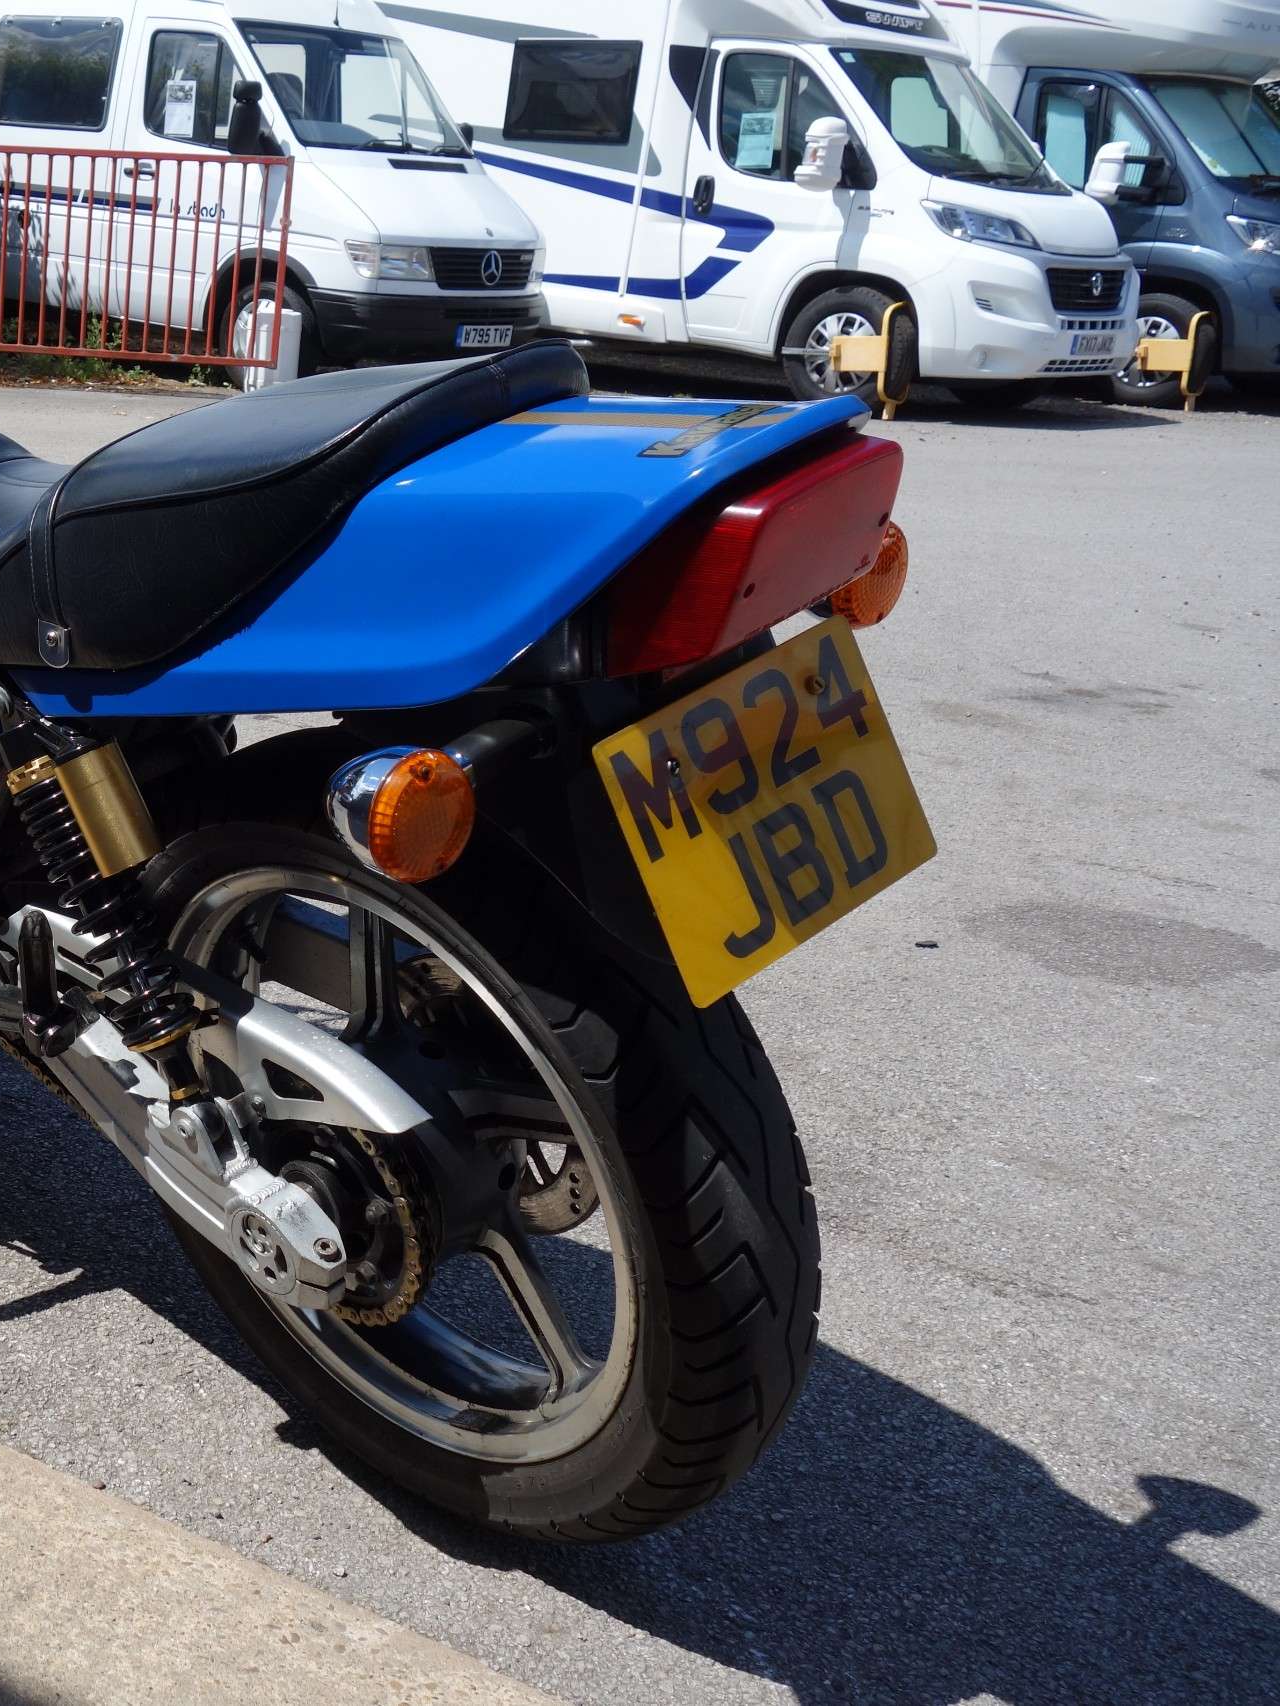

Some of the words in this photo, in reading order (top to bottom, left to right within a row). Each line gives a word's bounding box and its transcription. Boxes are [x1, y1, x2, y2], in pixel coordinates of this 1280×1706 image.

[464, 327, 491, 344] W795
[493, 327, 511, 344] TVF
[608, 633, 868, 863] M924
[723, 769, 888, 958] JBD
